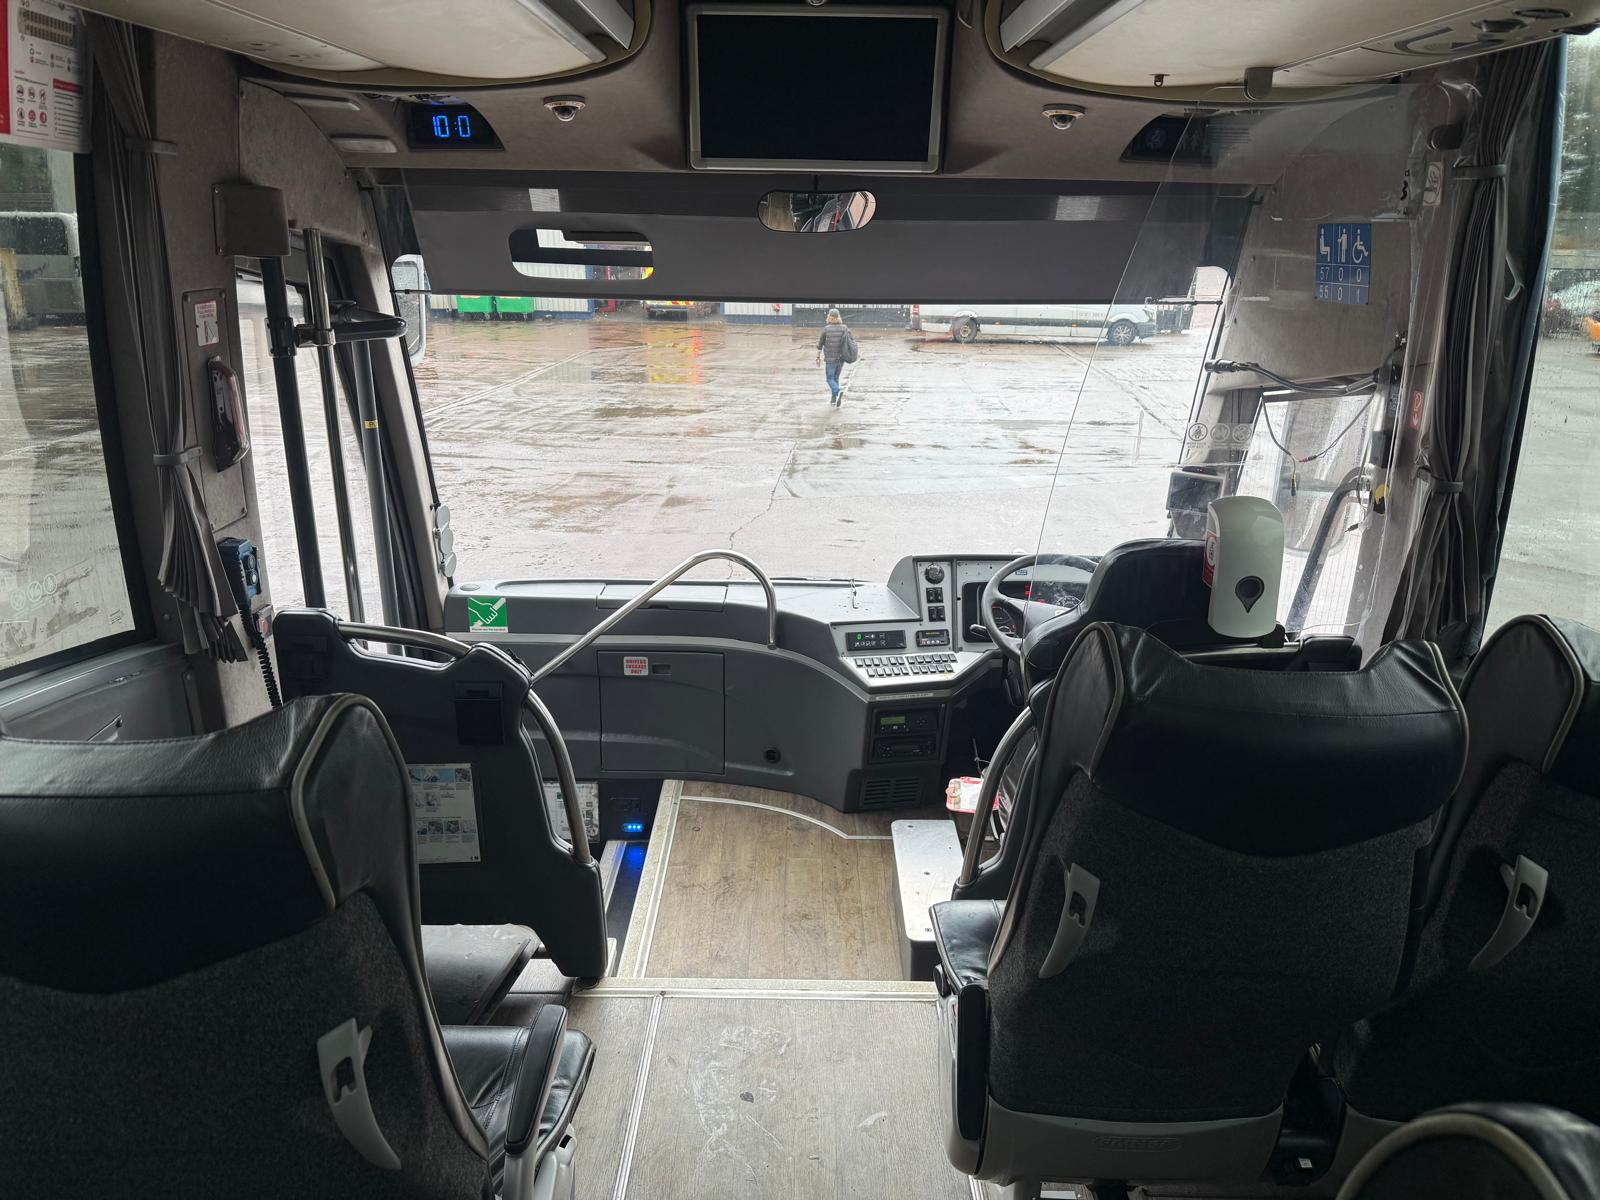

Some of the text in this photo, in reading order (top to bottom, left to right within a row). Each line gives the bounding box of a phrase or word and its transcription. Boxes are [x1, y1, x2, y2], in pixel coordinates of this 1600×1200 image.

[1319, 266, 1362, 283] 57 0 0
[1319, 285, 1329, 299] 55
[1337, 287, 1343, 301] 0
